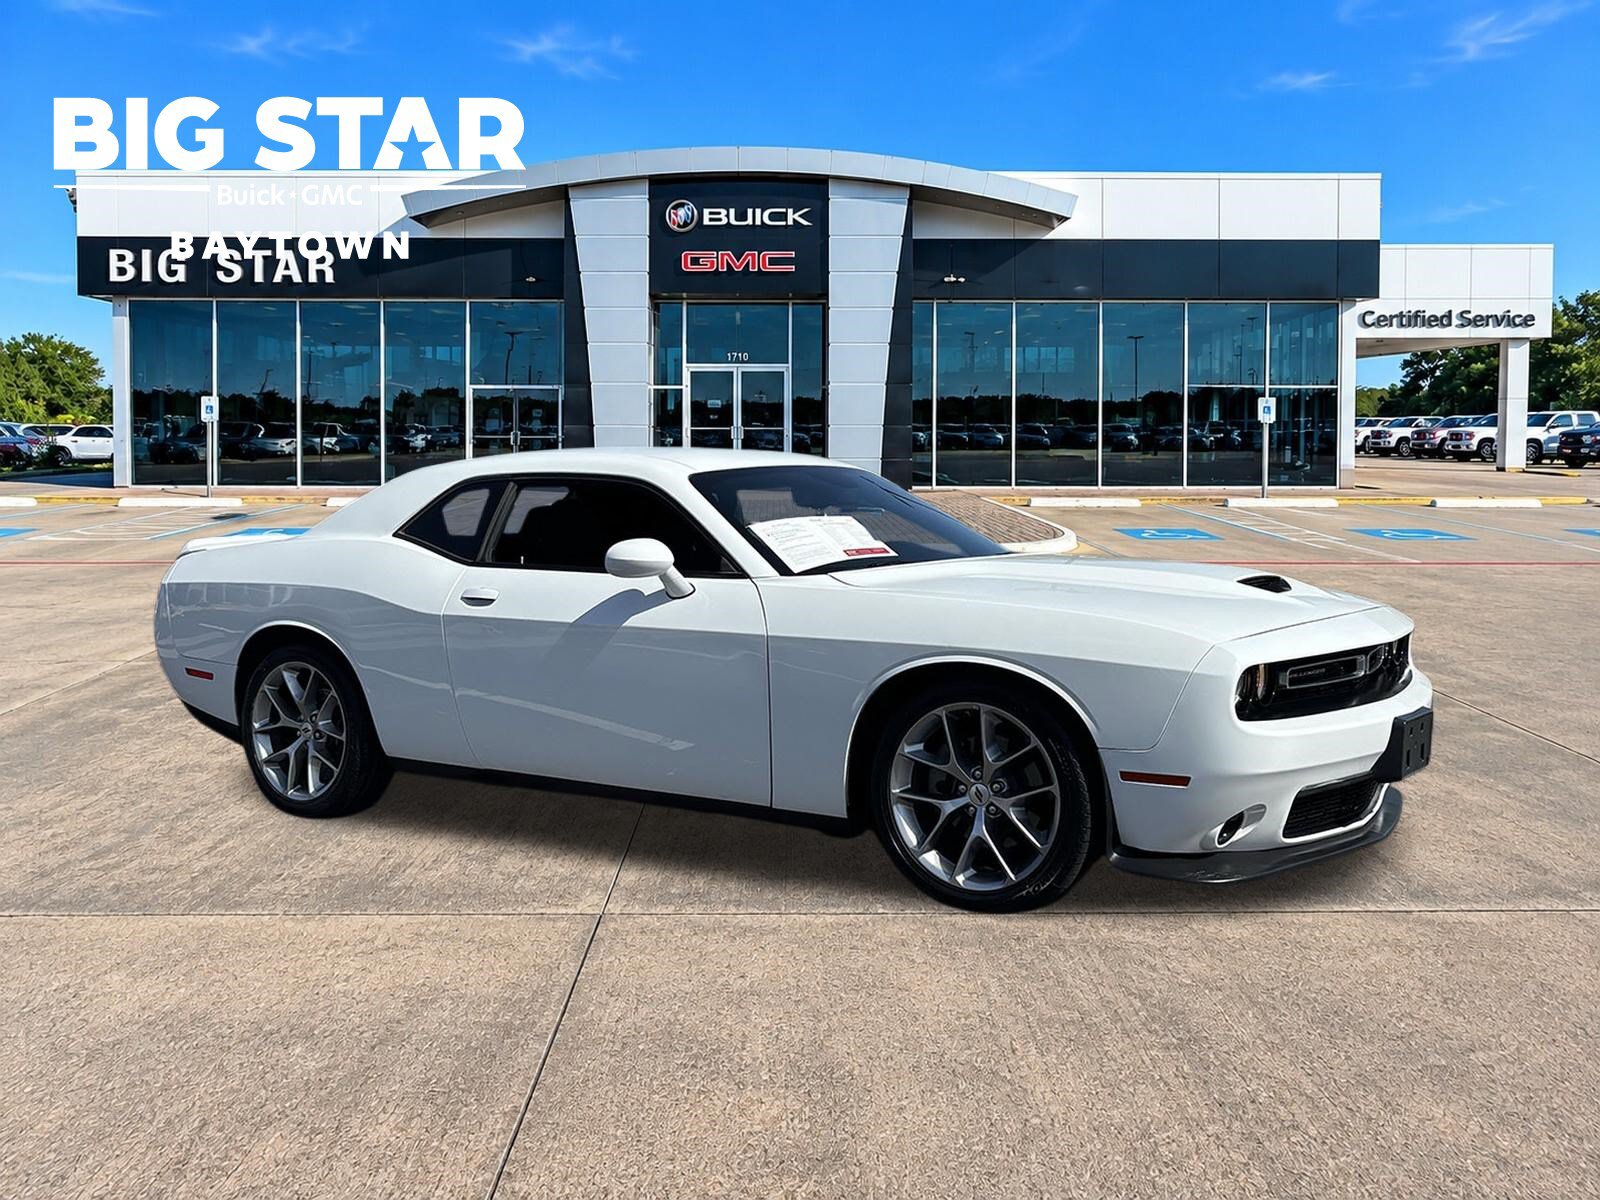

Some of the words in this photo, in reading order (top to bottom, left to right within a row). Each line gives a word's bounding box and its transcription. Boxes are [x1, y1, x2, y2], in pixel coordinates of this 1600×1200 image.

[702, 207, 813, 226] BUICK
[109, 248, 187, 284] BIG
[216, 248, 336, 284] STAR
[681, 251, 795, 272] GMC
[1359, 309, 1453, 329] Certified
[1456, 309, 1536, 329] Service
[727, 352, 749, 361] 1710
